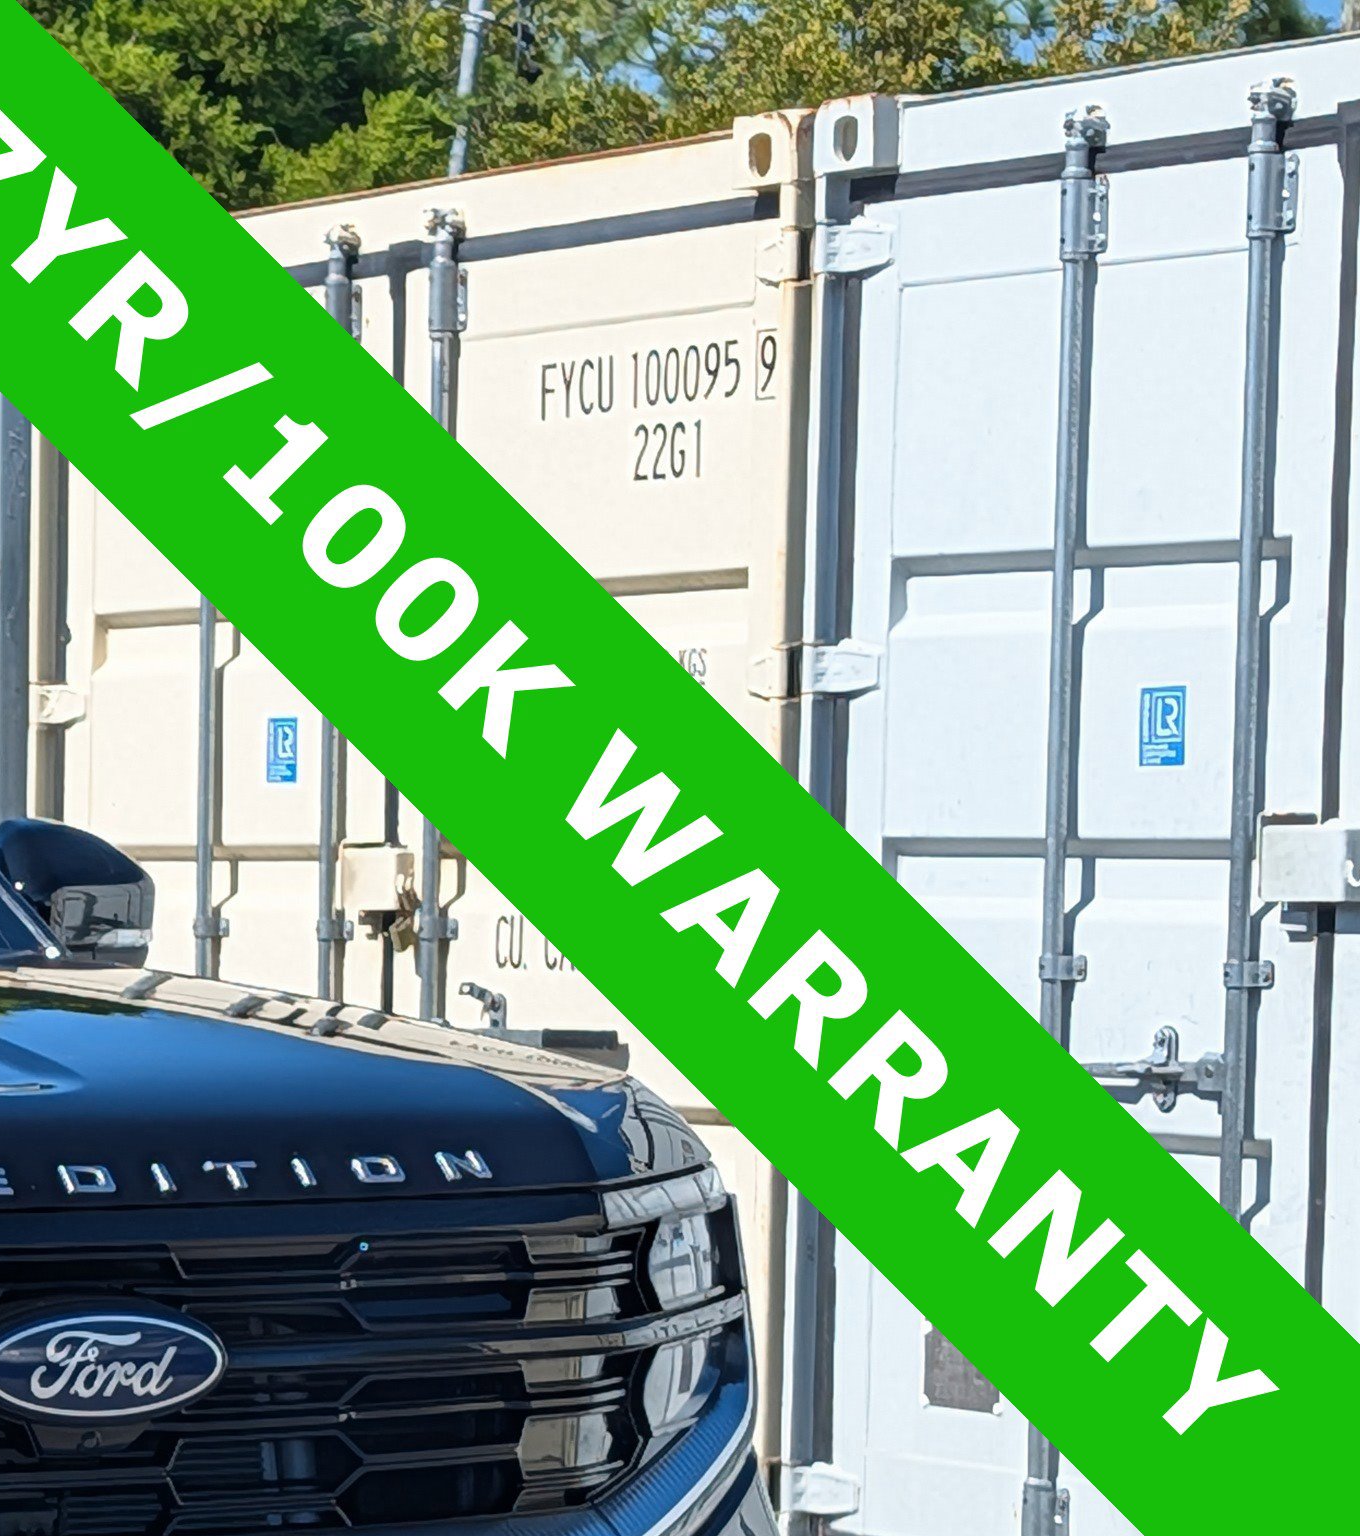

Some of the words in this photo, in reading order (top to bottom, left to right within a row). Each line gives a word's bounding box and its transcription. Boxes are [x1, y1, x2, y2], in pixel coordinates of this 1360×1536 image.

[541, 354, 614, 421] FYCU
[631, 340, 741, 409] 100095
[760, 334, 778, 393] 9
[633, 418, 702, 481] 22G1
[495, 914, 528, 970] CU.
[31, 1330, 177, 1400] Ford
